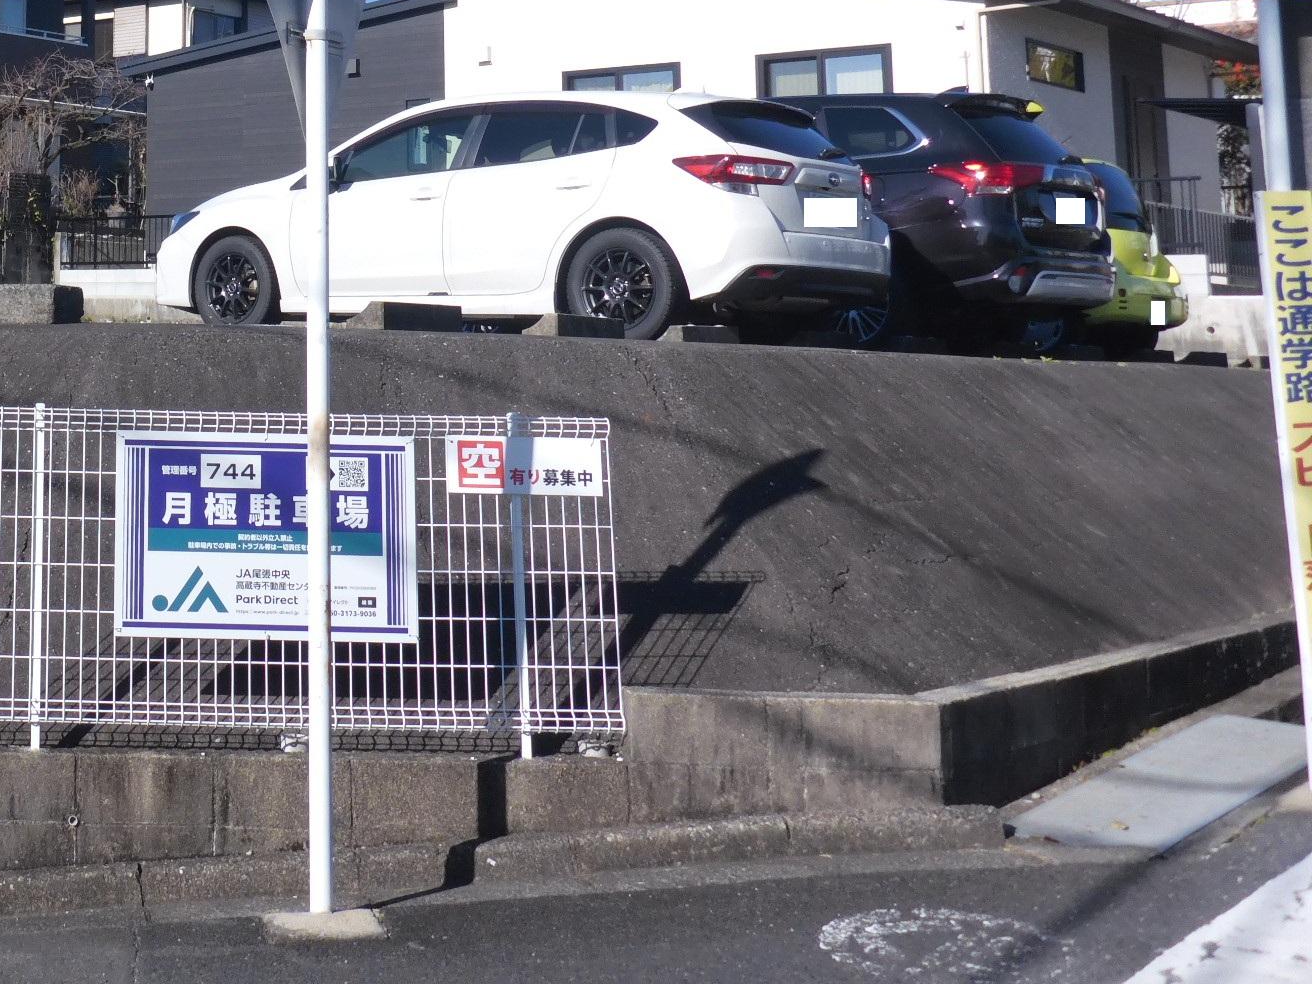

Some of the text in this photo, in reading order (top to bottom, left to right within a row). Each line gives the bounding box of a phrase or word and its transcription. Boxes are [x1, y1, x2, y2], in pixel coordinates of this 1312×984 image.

[161, 465, 197, 476] 管理番号
[206, 462, 256, 480] 744
[461, 443, 501, 485] 空
[509, 468, 593, 487] 有り募集中
[235, 568, 290, 579] JA尾張中央
[235, 594, 299, 605] Park Direct
